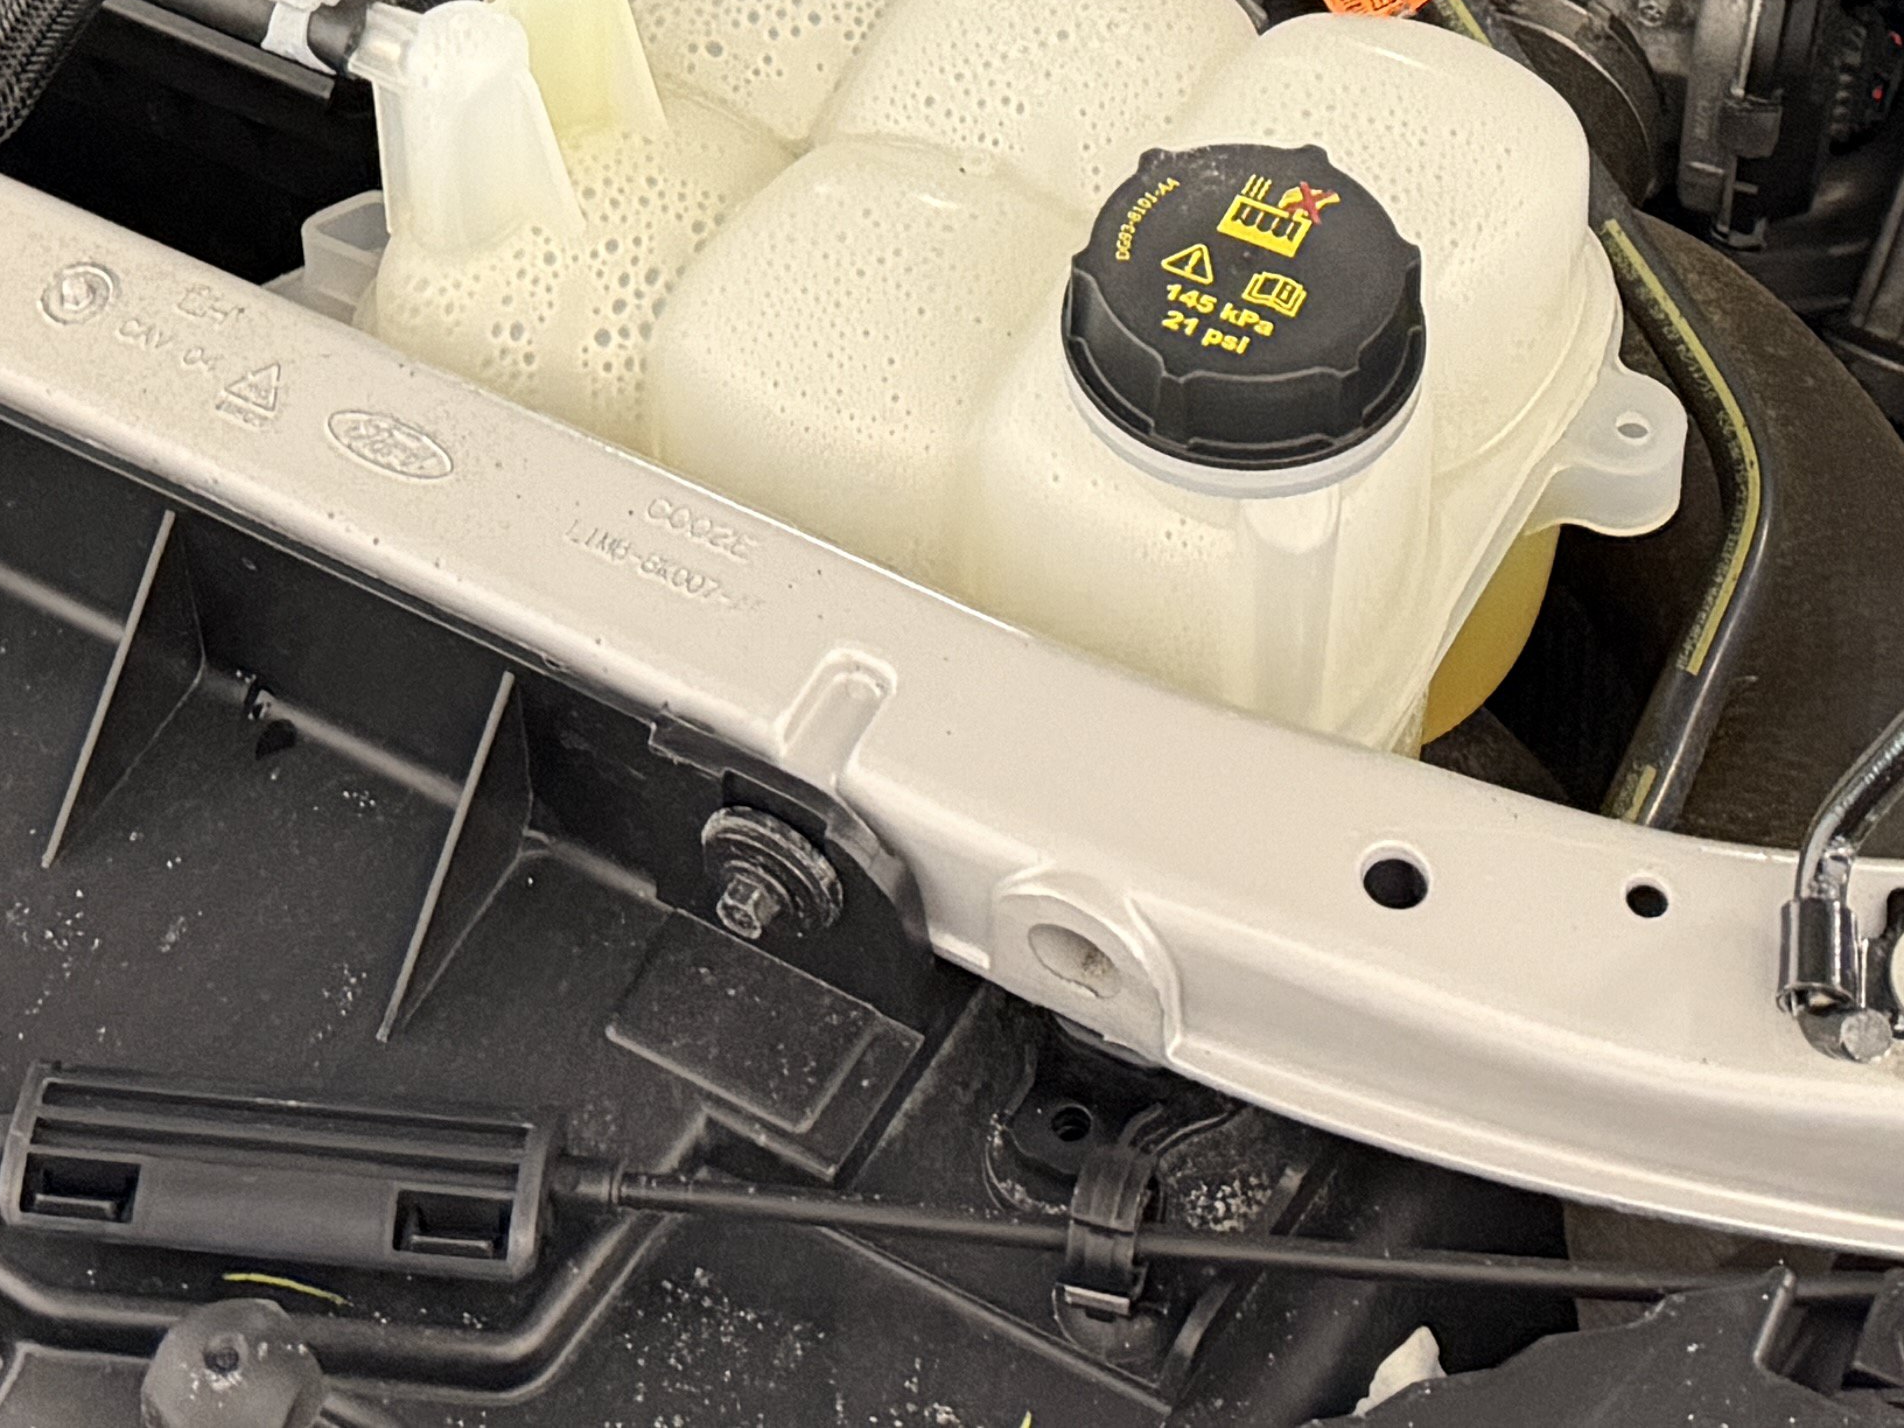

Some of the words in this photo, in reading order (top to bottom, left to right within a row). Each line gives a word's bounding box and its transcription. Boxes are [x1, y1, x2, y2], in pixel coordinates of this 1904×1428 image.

[1161, 310, 1200, 336] 21
[1201, 328, 1251, 355] psi
[1166, 283, 1218, 314] 145
[1219, 302, 1275, 337] kPa
